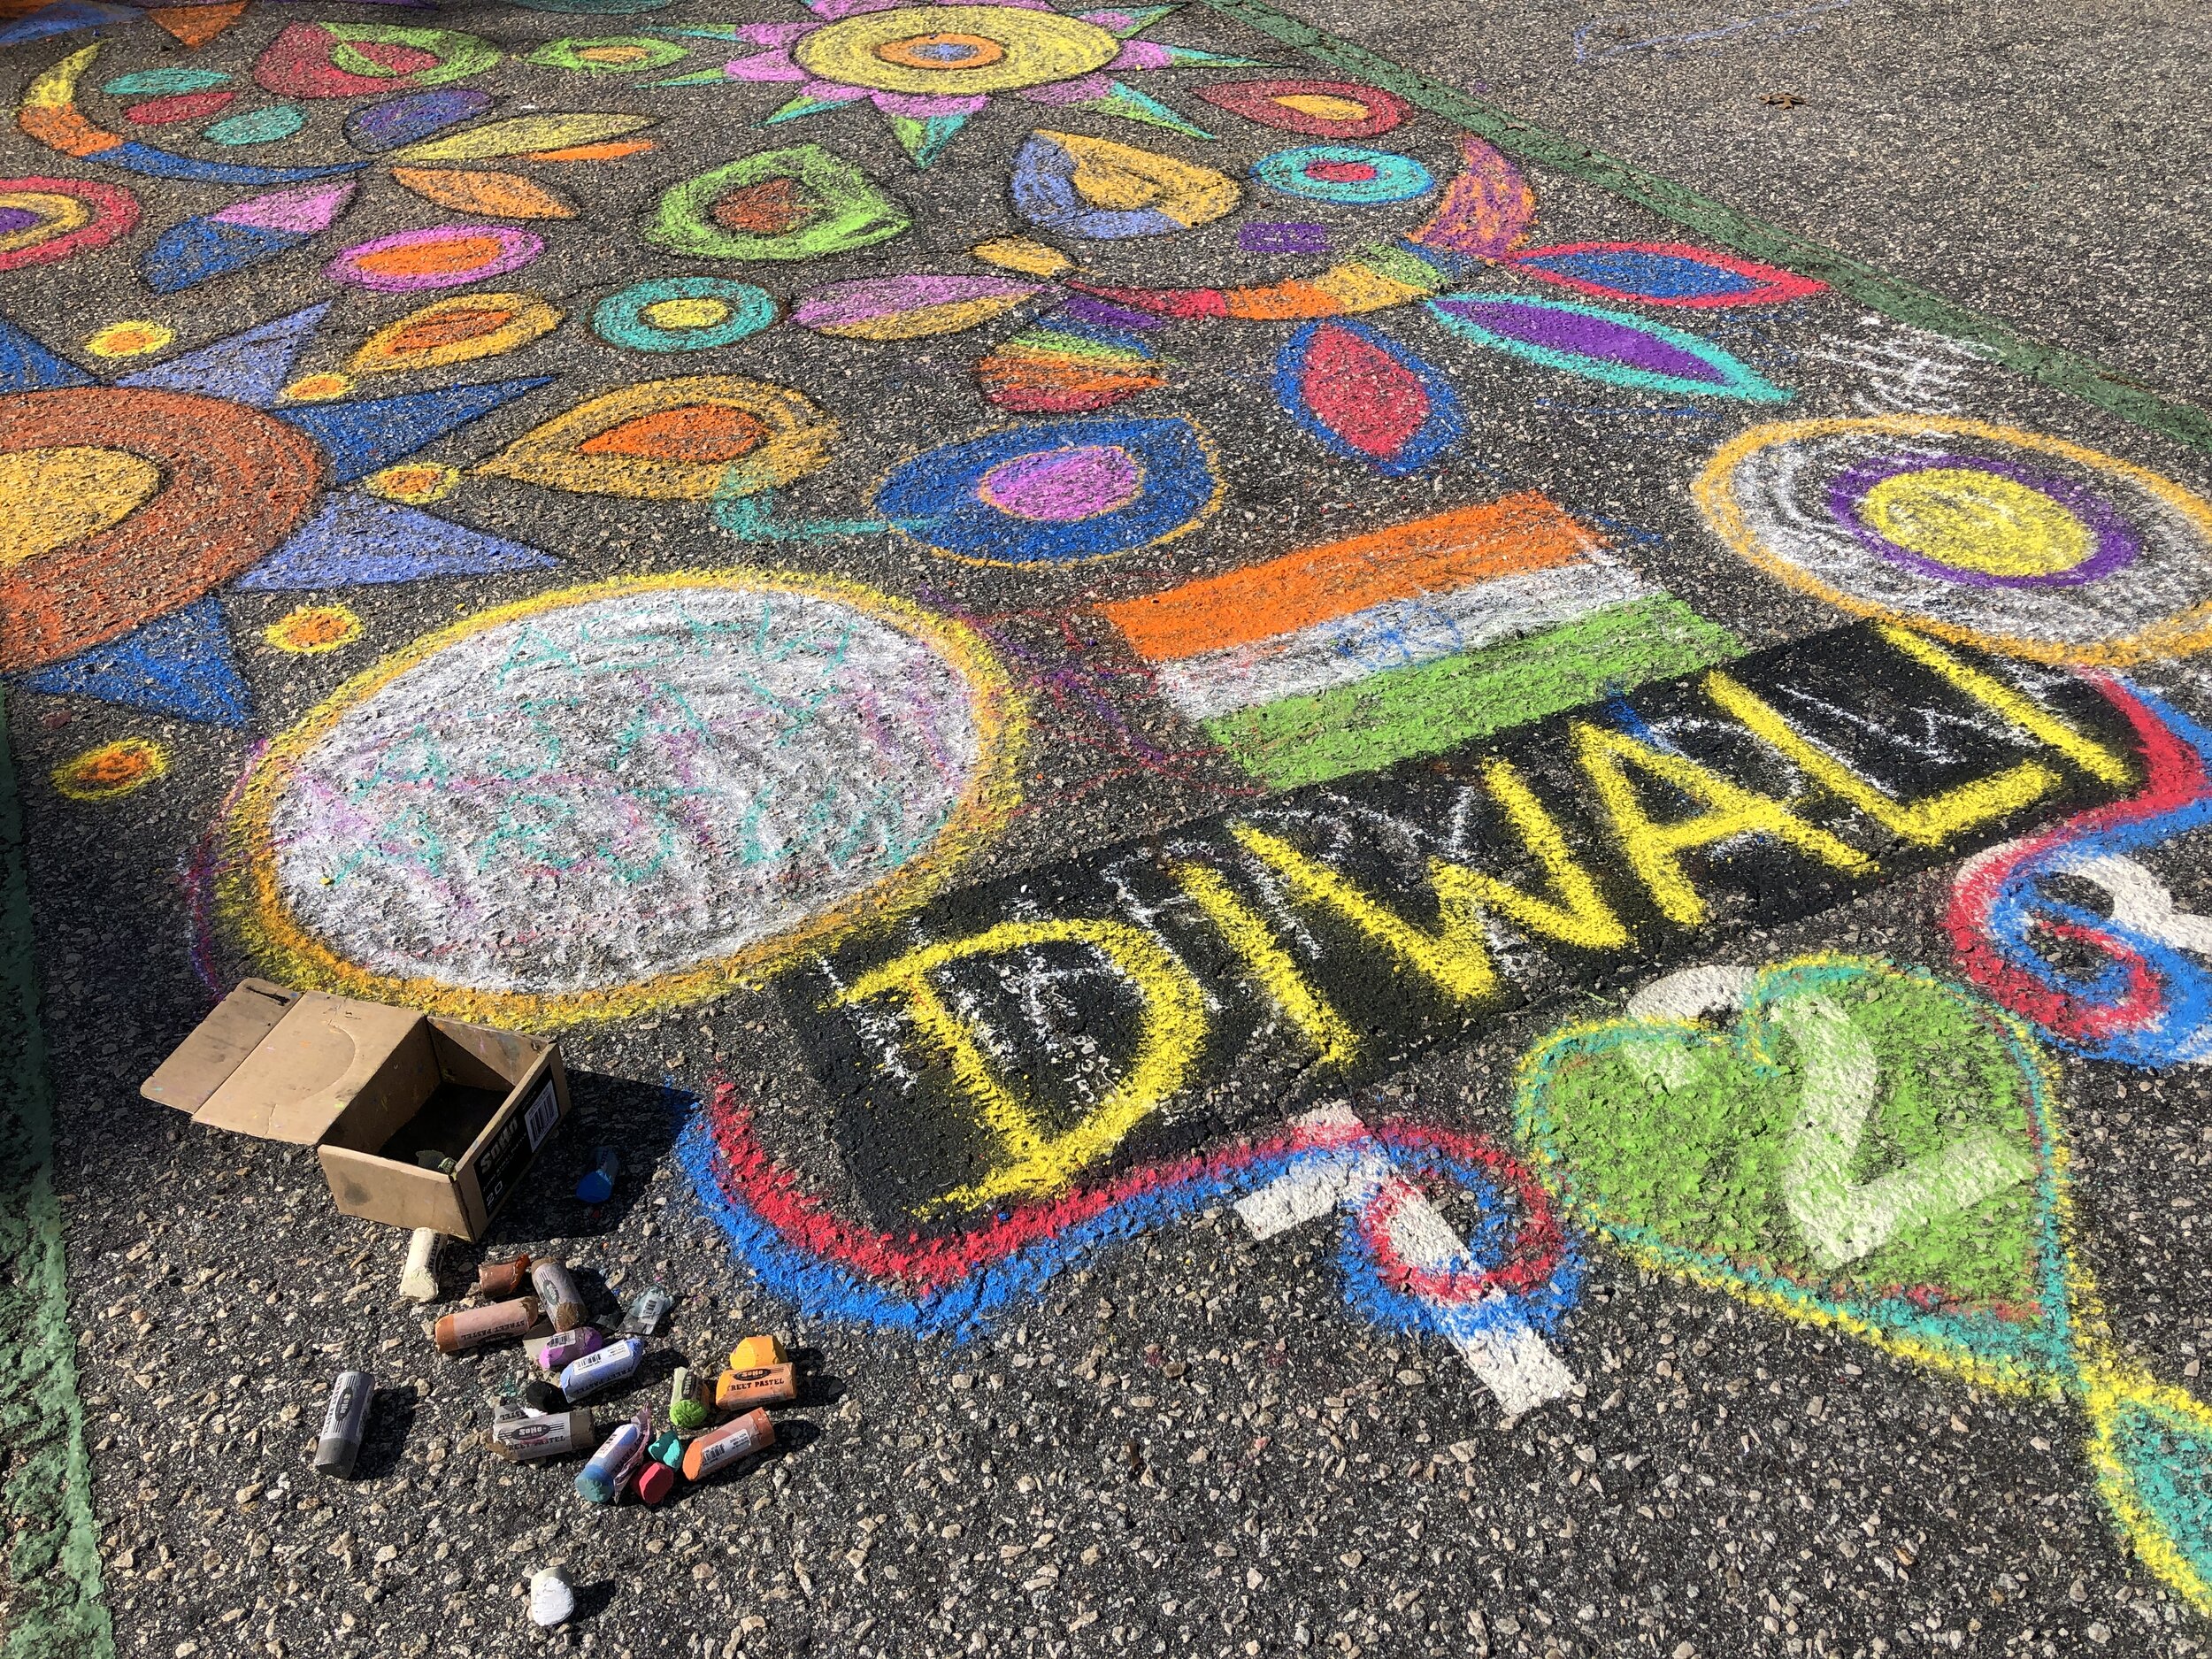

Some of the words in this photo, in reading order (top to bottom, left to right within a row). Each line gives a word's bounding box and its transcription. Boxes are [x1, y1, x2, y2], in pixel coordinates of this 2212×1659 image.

[816, 623, 2137, 1224] DIWALI
[494, 1319, 526, 1333] STREET
[460, 1326, 493, 1341] PASTEL
[754, 1378, 786, 1388] PASTEL
[518, 1425, 542, 1437] SoHo
